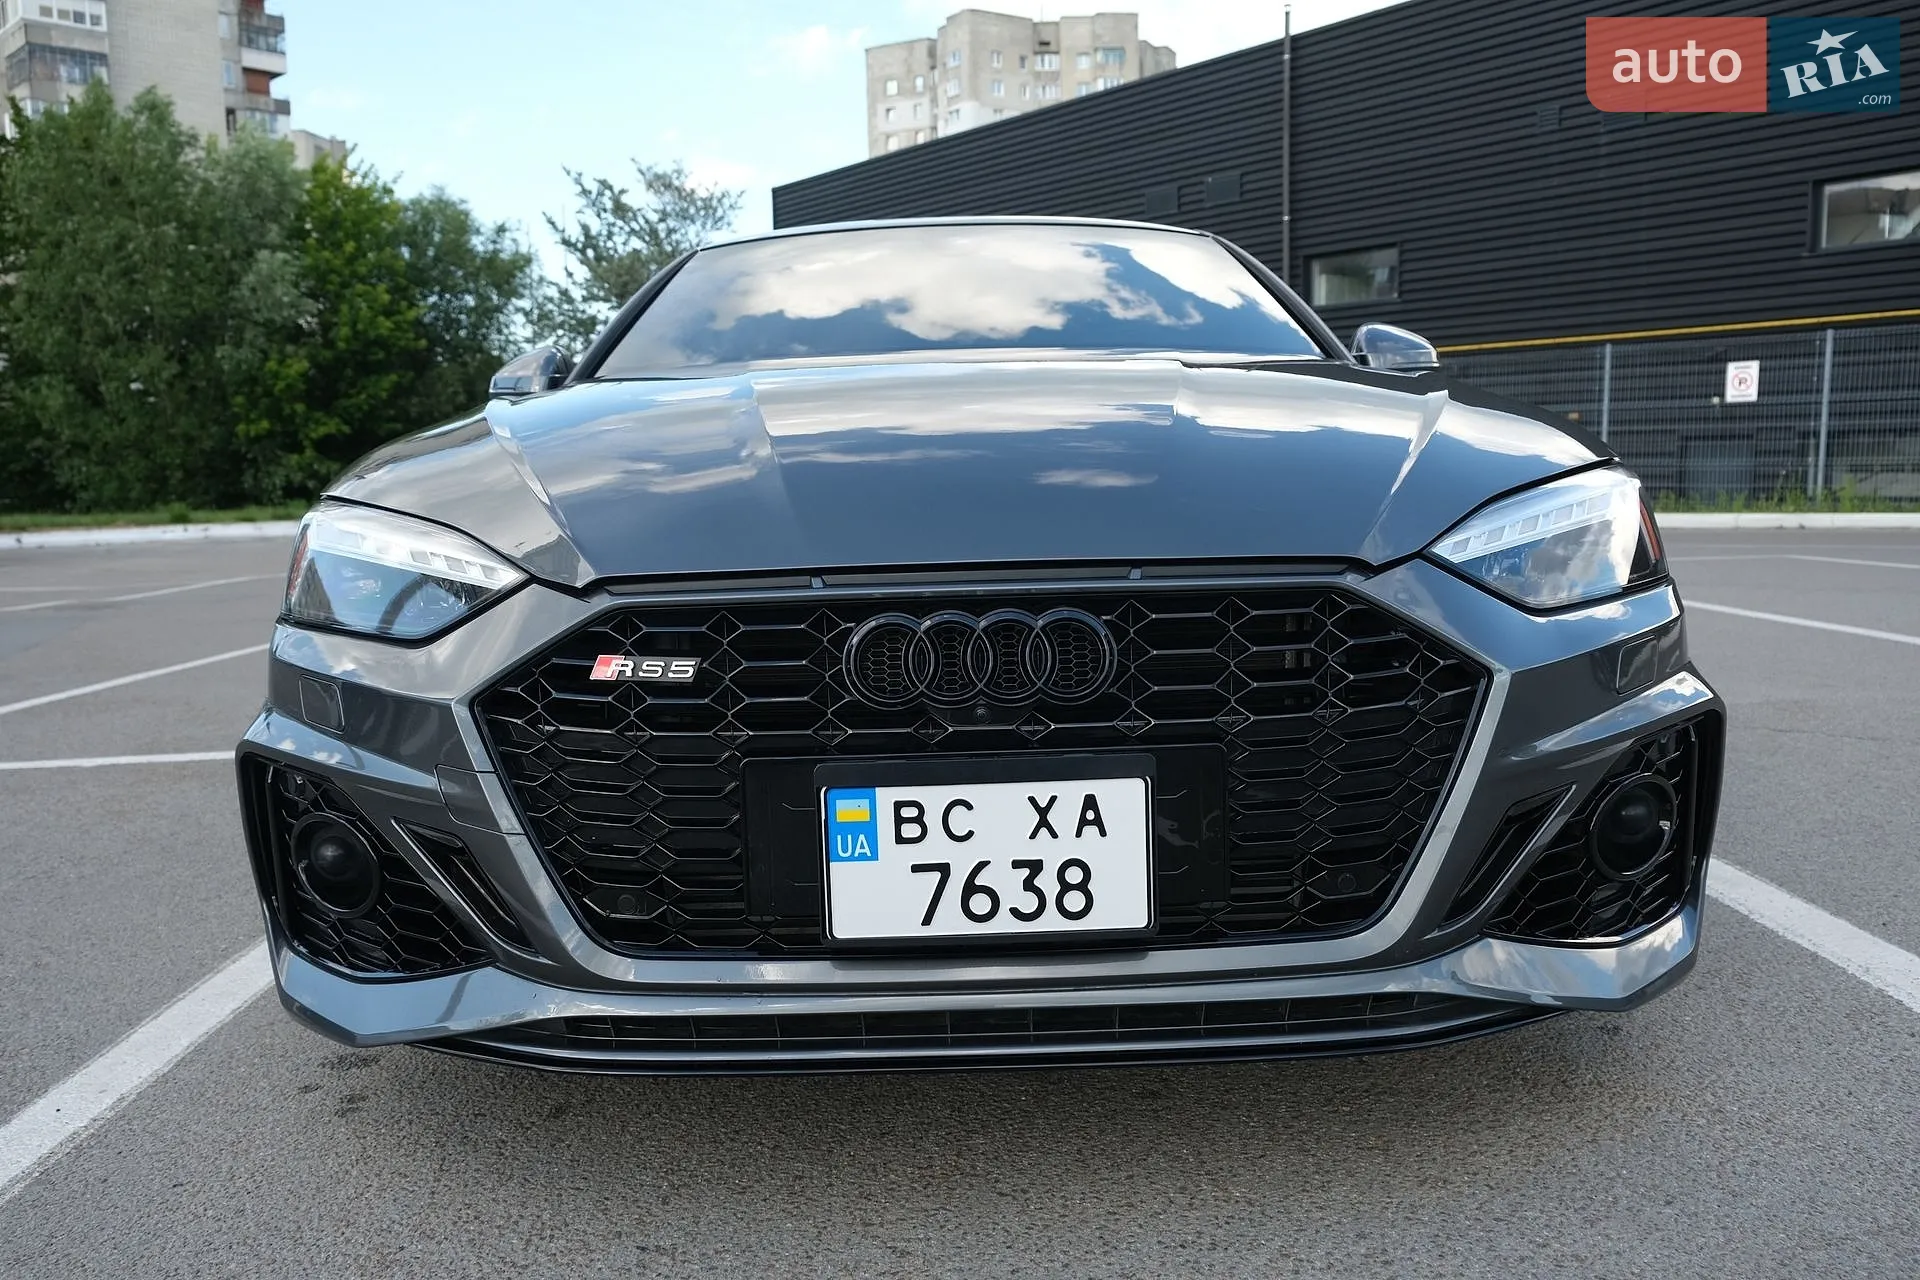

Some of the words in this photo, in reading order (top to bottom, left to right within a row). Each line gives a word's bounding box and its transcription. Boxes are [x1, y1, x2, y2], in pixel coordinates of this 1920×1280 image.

[605, 659, 696, 678] RS5
[893, 798, 975, 844] BC
[1027, 794, 1107, 839] XA
[836, 834, 872, 858] UA
[910, 857, 1094, 926] 7638
